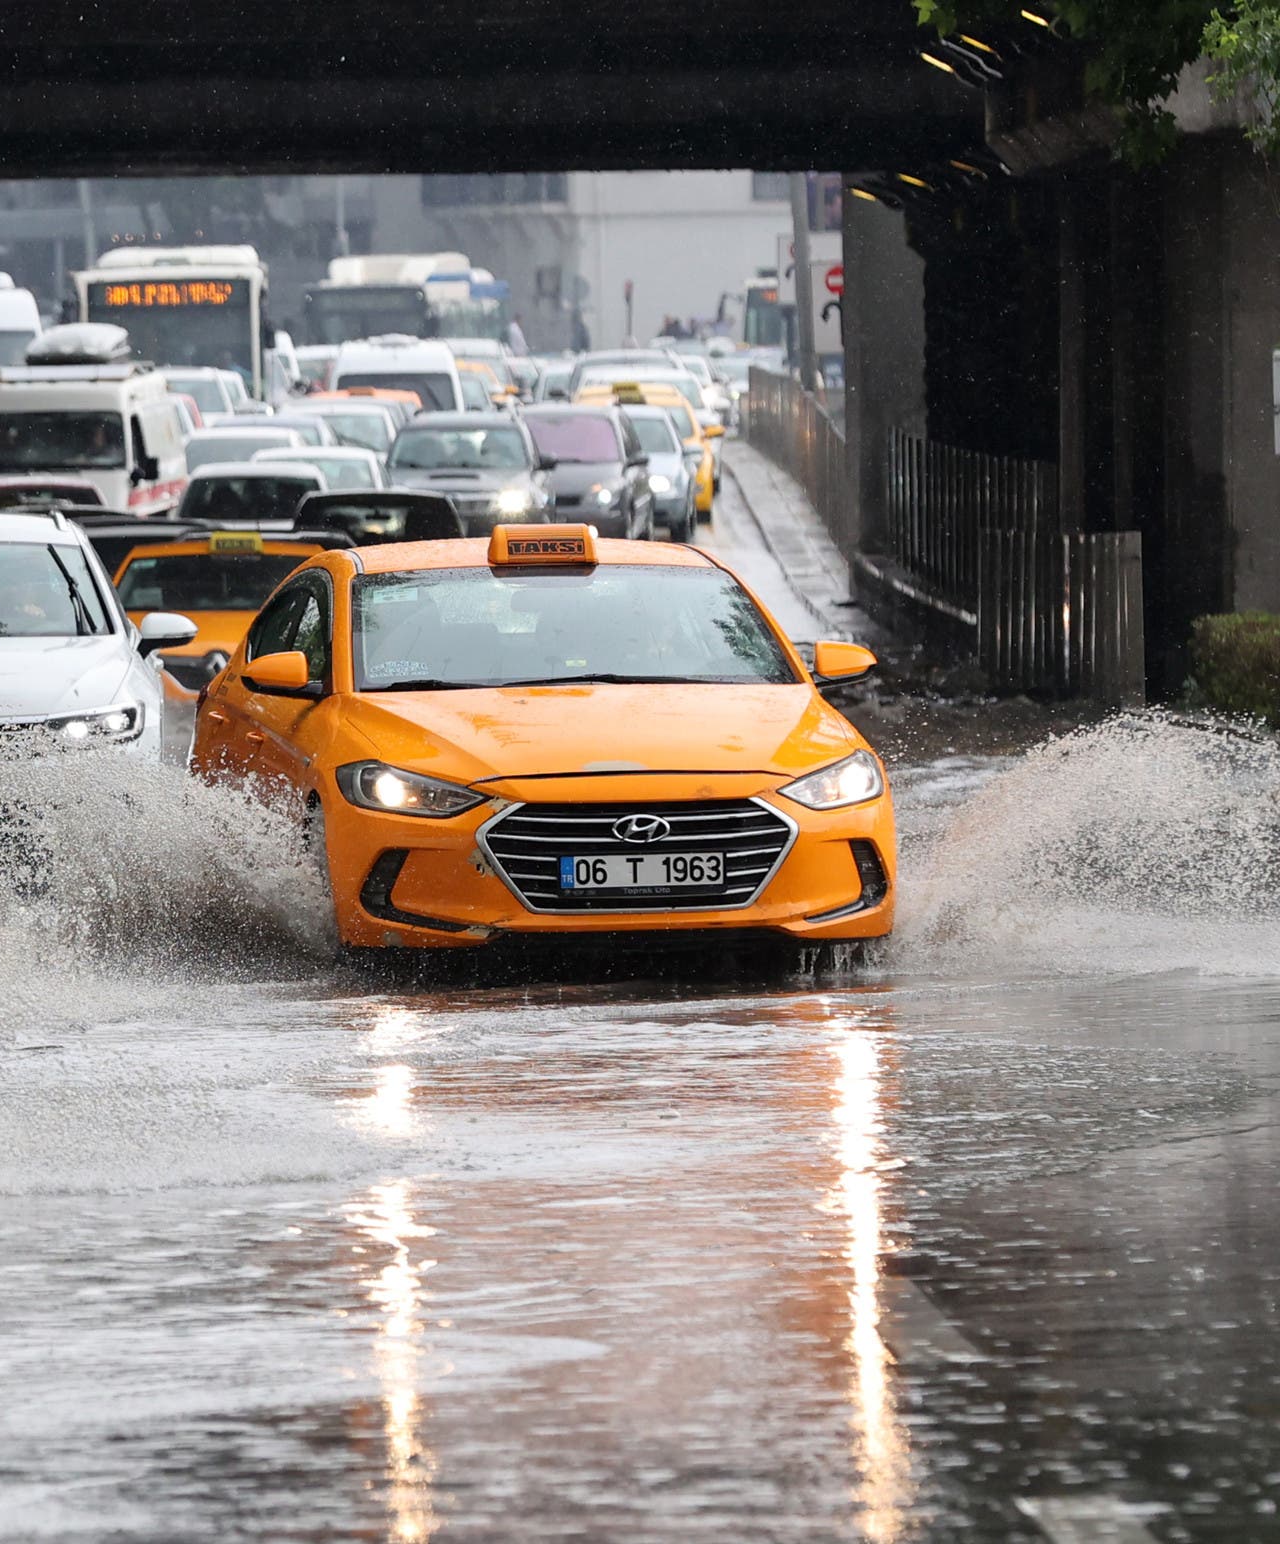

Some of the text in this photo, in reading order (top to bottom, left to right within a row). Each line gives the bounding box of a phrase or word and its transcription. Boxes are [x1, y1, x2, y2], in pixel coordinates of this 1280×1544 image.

[561, 855, 721, 885] TR 06 T 1963
